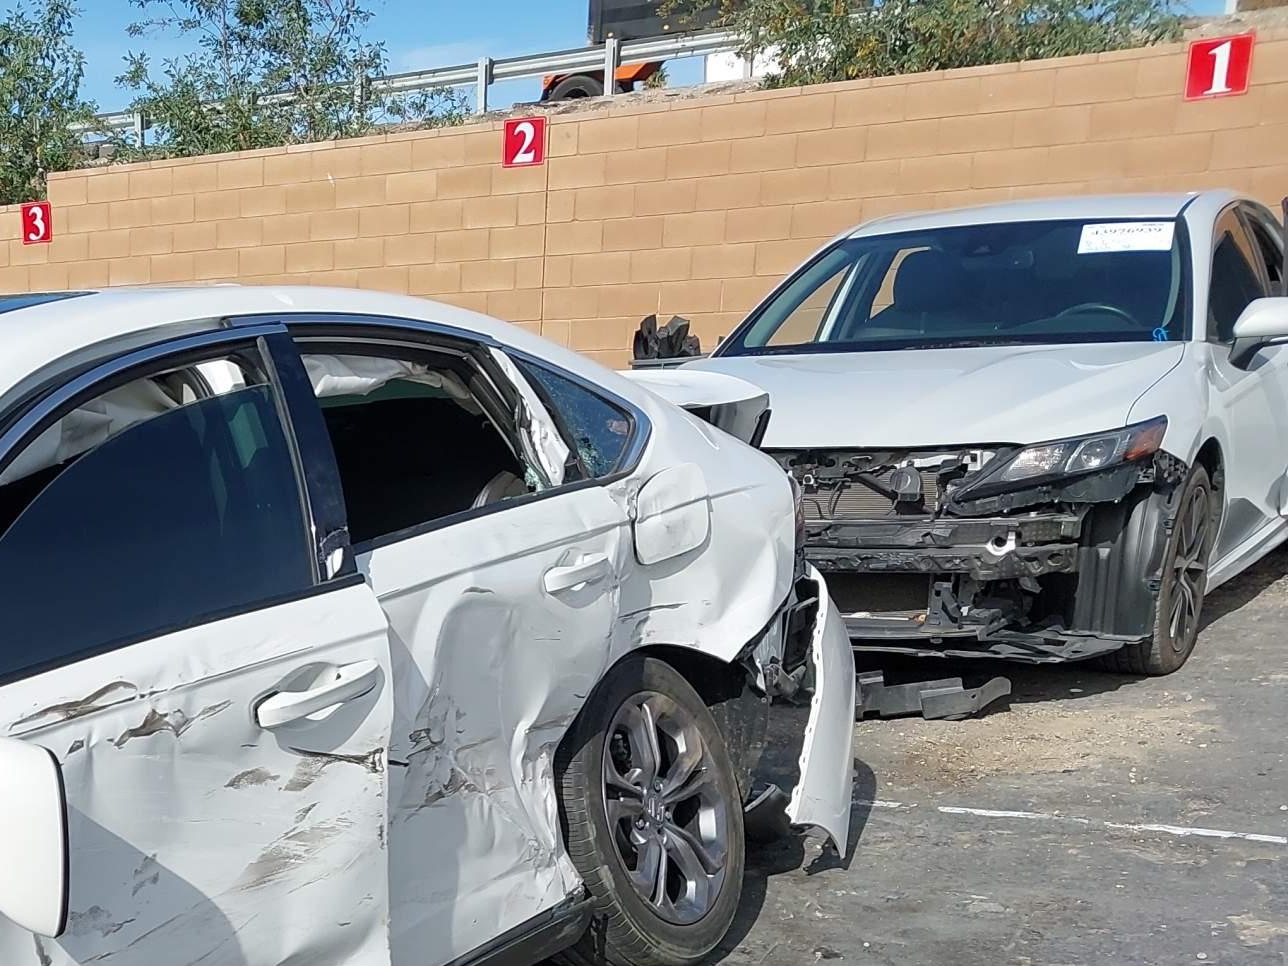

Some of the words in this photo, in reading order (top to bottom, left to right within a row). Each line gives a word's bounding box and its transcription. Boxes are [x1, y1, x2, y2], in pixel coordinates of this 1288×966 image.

[1203, 40, 1232, 94] 1
[512, 121, 536, 164] 2
[28, 206, 45, 241] 3
